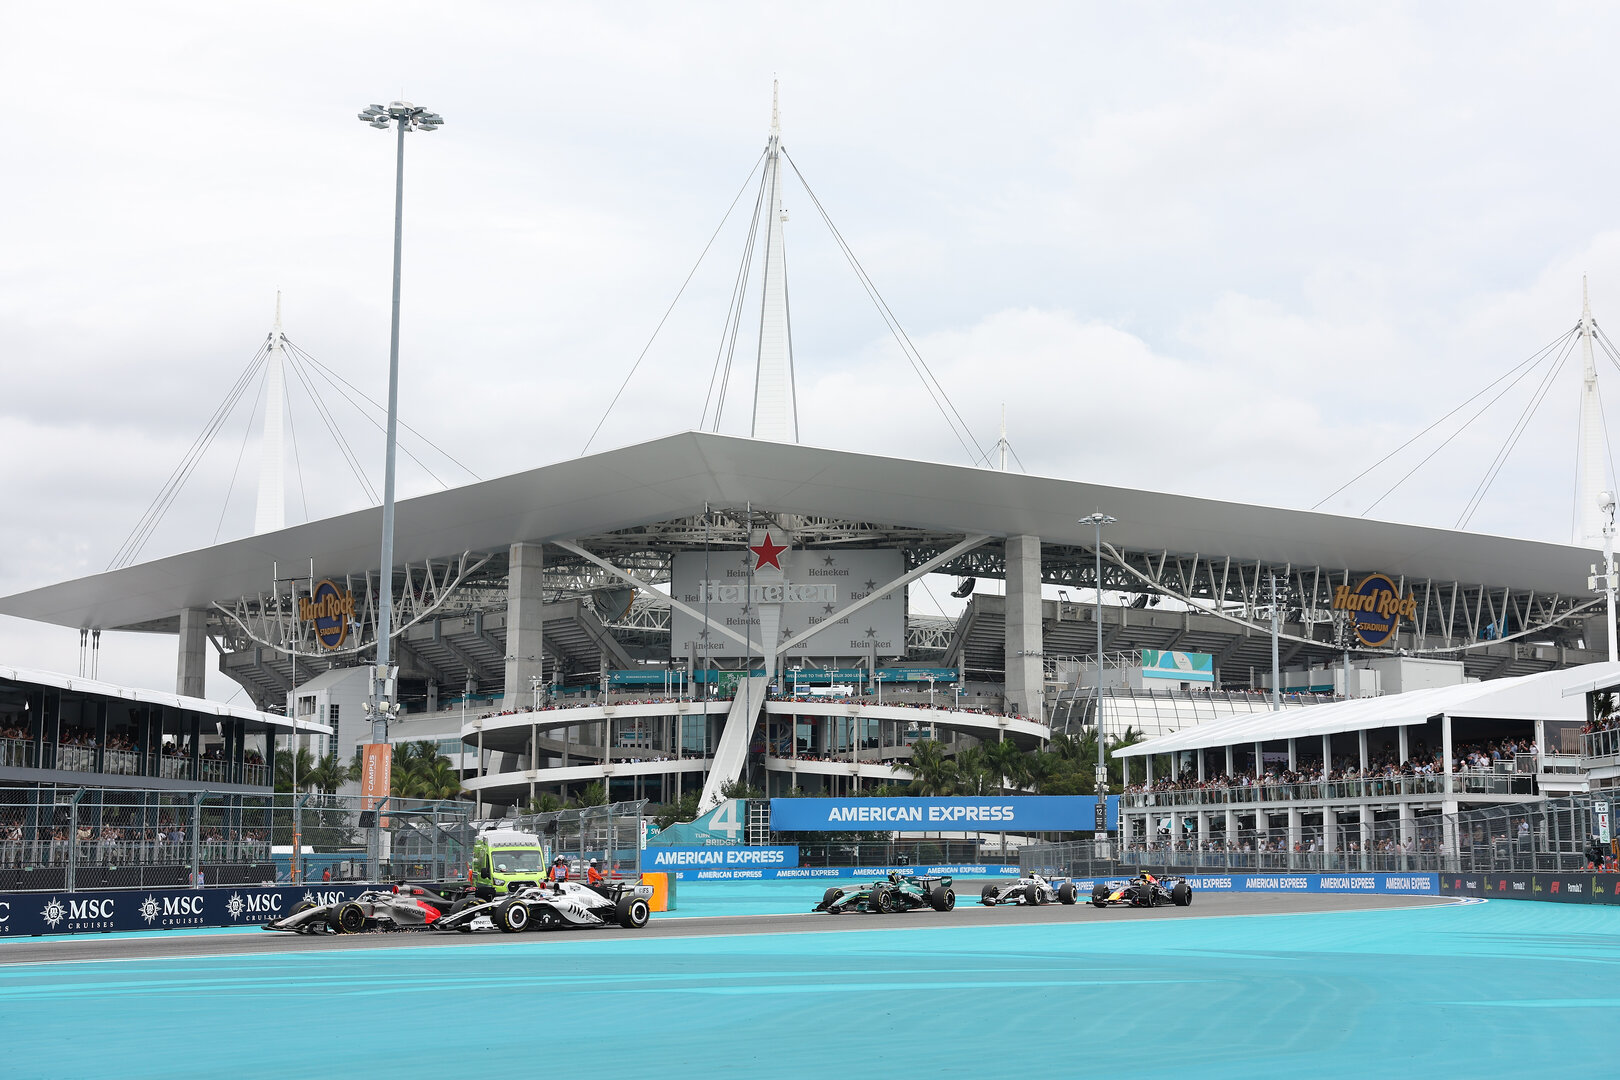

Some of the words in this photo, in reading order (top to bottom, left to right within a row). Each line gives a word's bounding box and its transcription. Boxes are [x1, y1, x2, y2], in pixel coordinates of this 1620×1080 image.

[808, 568, 849, 576] Heineken
[699, 578, 835, 604] Heineken
[299, 594, 327, 622] Hard
[326, 590, 356, 621] Rock
[1333, 585, 1378, 612] Hard
[1377, 589, 1417, 622] Rock
[320, 626, 340, 636] STADIUM
[1359, 622, 1388, 632] STADIUM
[850, 640, 891, 648] Heinken
[708, 800, 742, 838] 4
[828, 807, 922, 822] AMERICAN
[928, 806, 1015, 821] EXPRESS
[654, 851, 723, 865] AMERICAN
[726, 850, 784, 863] EXPRESS
[697, 871, 732, 879] AMERICAN
[1076, 881, 1095, 890] EXPRESS
[1203, 878, 1232, 888] EXPRESS
[1246, 878, 1279, 888] AMERICAN
[1280, 877, 1308, 888] EXPRESS
[1320, 877, 1350, 889] AMERICAN
[1350, 877, 1375, 889] EXPRESS
[1385, 877, 1411, 889] AMERICAN
[1411, 877, 1431, 889] EXPRESS
[246, 893, 282, 912] MSC
[317, 891, 345, 907] MSC
[68, 899, 114, 920] MSC
[162, 896, 204, 916] MSC
[68, 921, 114, 930] CRUISES
[162, 917, 204, 925] CRUISES
